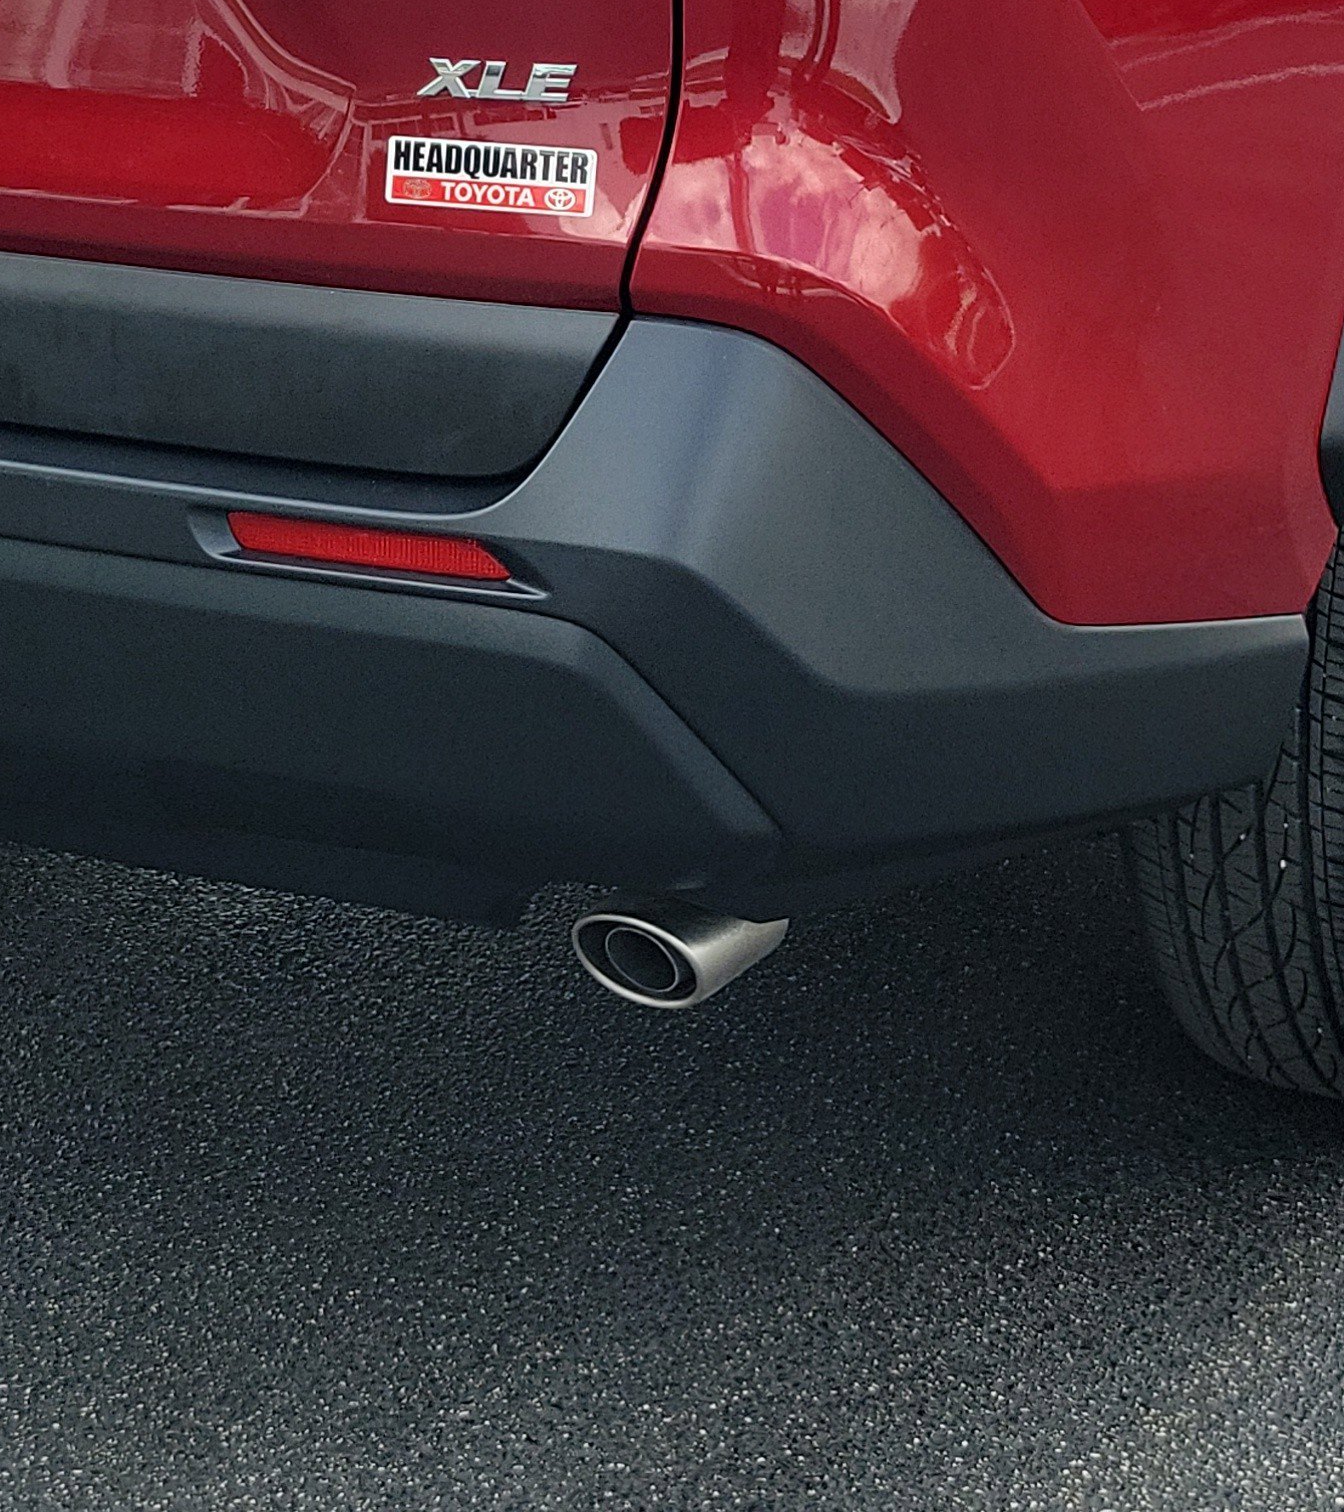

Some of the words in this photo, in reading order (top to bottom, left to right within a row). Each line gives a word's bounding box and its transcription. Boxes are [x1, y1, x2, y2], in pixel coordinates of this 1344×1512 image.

[417, 57, 578, 102] XLE
[393, 139, 589, 185] HEADQUARTER
[440, 181, 536, 207] TOYOTA
